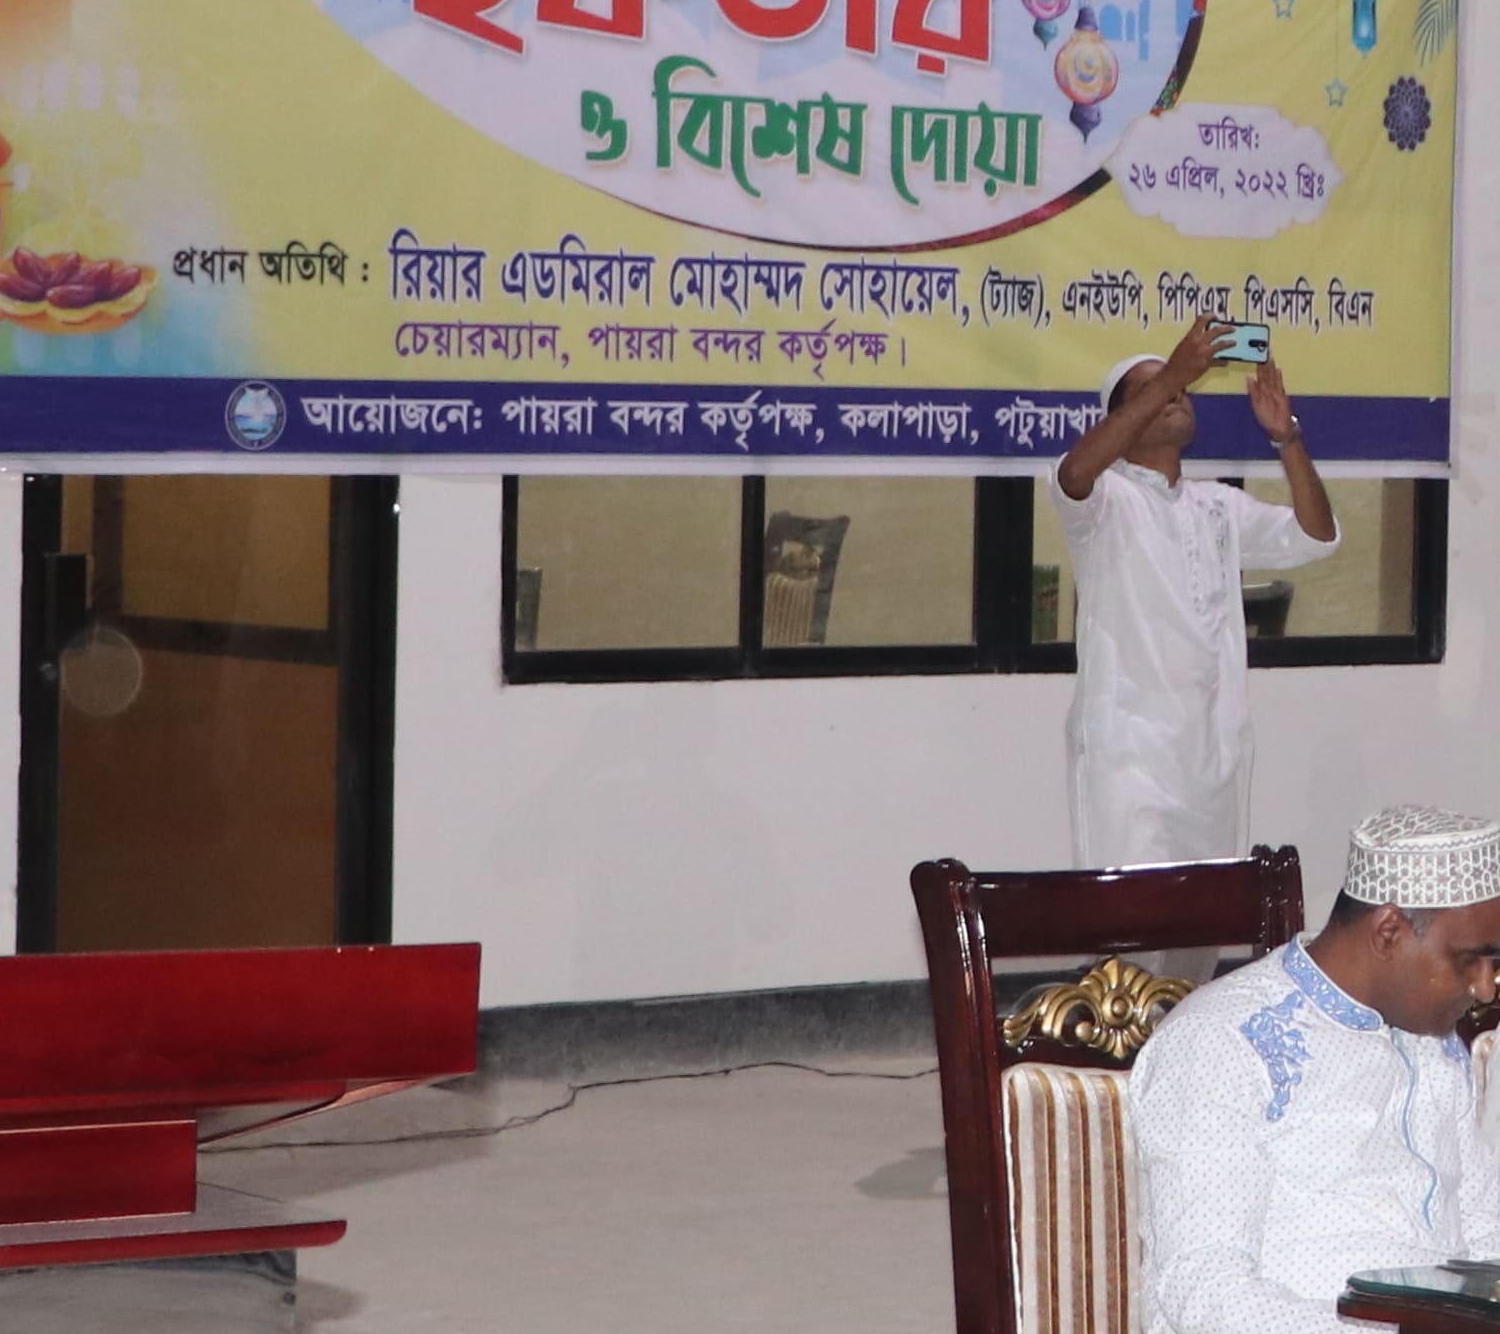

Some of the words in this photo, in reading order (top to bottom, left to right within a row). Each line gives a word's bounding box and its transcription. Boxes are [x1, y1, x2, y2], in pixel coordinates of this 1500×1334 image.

[581, 87, 626, 161] ও
[653, 56, 869, 199] বিশেষ
[891, 103, 1041, 206] দোয়া
[1128, 163, 1157, 191] ২৬
[1165, 156, 1225, 199] এপ্রিল,
[1234, 171, 1289, 199] ২০২২
[172, 247, 248, 286] প্রধান
[258, 240, 348, 287] অতিথি
[387, 226, 486, 302] রিয়ার
[500, 232, 656, 306] এডমিরাল
[669, 251, 806, 315] মোহাম্মদ
[819, 254, 970, 327] সোহায়েল,
[1062, 268, 1149, 330] এনইউপি,
[1243, 273, 1321, 333] পিএসসি,
[1327, 276, 1374, 330] বিএন
[395, 319, 571, 368] চেয়ারম্যান,
[587, 323, 680, 361] পায়রা
[691, 327, 766, 363] বন্দর
[777, 318, 889, 380] কর্তৃপক্ষ
[500, 396, 598, 436] পায়রা
[608, 399, 689, 437] বন্দর
[698, 389, 825, 450] কর্তৃপক্ষ,
[838, 400, 980, 446] কলাপাড়া,
[993, 396, 1105, 447] পটুয়াখা
